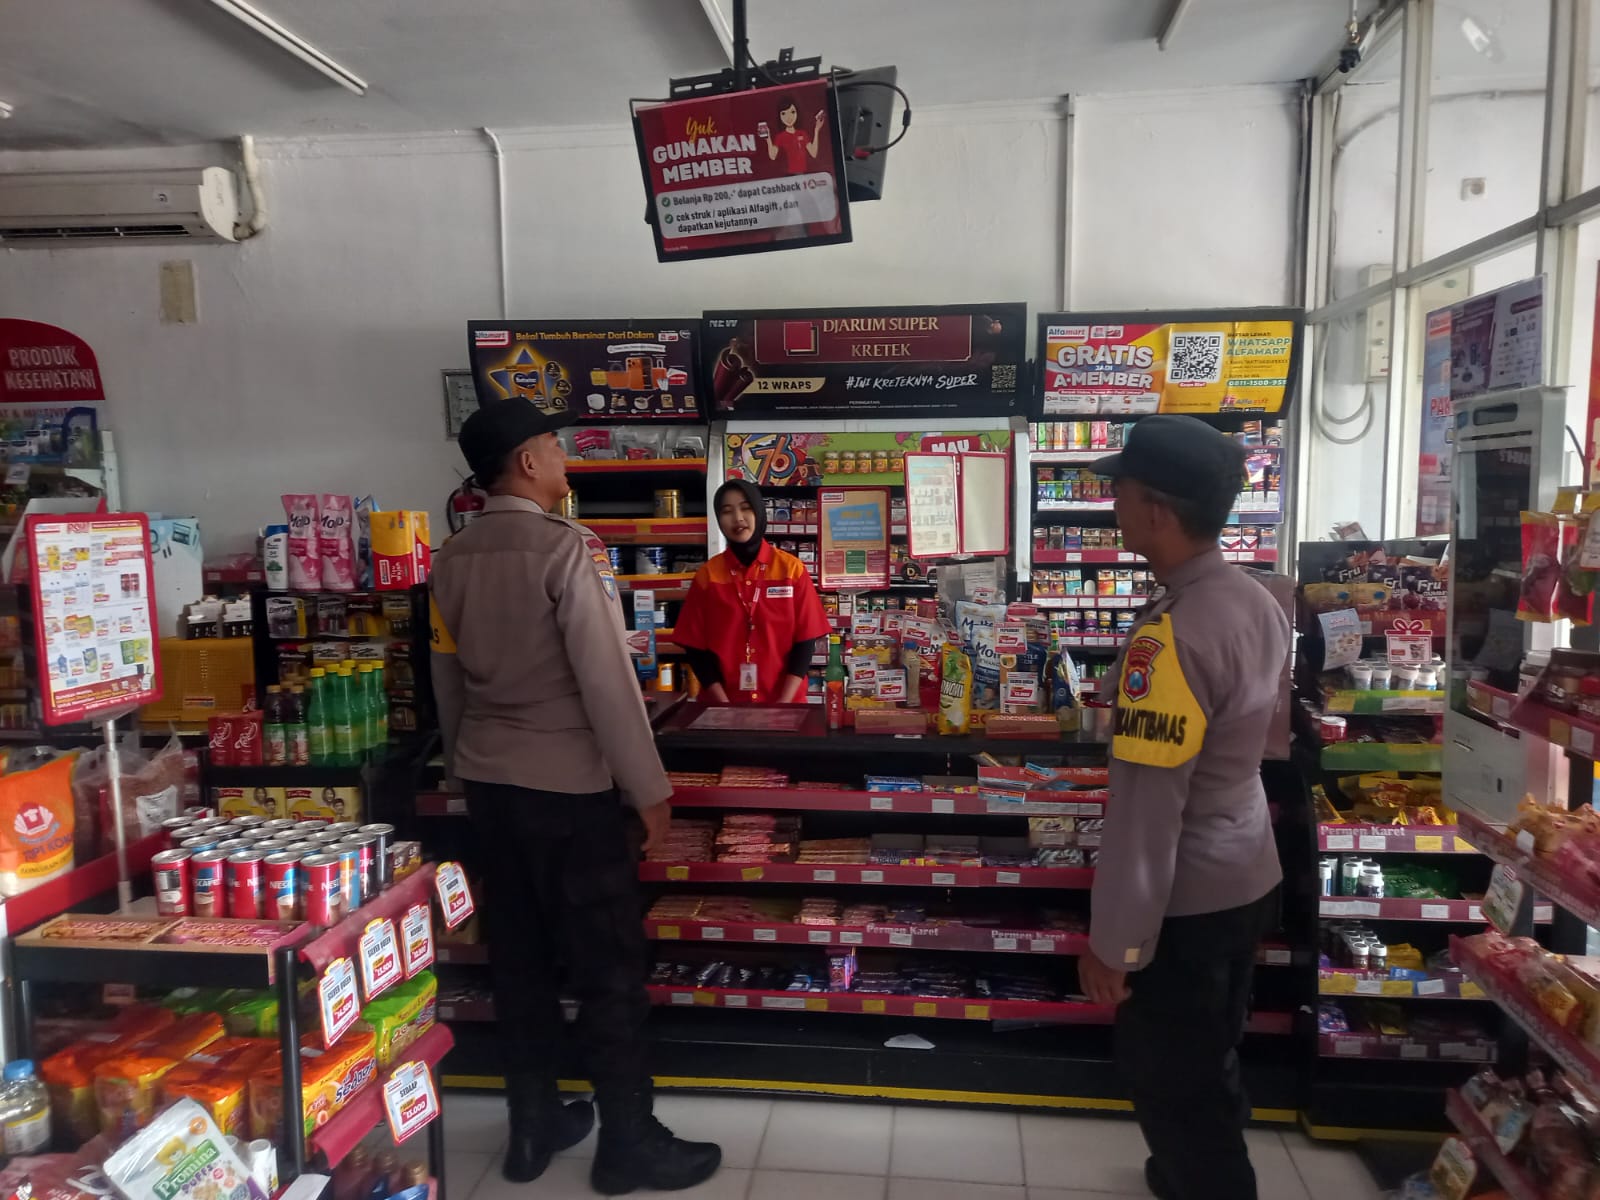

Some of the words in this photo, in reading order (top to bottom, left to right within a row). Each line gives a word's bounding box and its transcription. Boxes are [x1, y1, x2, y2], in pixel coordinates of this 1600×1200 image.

[652, 134, 756, 164] GUNAKAN
[662, 157, 753, 184] MEMBER
[673, 193, 702, 207] Belanja
[703, 193, 713, 204] Rp
[738, 187, 760, 200] dapat
[761, 181, 801, 195] Cashback
[676, 212, 690, 222] cek
[691, 209, 712, 221] struk
[717, 205, 748, 219] aplikasi
[749, 201, 778, 215] Alfagift
[678, 220, 713, 233] dapatkan
[714, 216, 758, 231] kejutannya
[823, 317, 886, 333] DJARUM
[890, 316, 939, 331] SUPER
[1048, 328, 1086, 336] Alfamart
[608, 331, 625, 340] Dari
[627, 331, 654, 340] Dalam
[1227, 337, 1291, 346] WHATSAPP
[8, 345, 80, 369] PRODUK
[851, 342, 911, 357] KRETEK
[1058, 344, 1154, 369] GRATIS
[1226, 347, 1287, 356] ALFAMART
[3, 368, 96, 390] KESEHATAN
[757, 380, 769, 390] 12
[771, 379, 812, 390] WRAPS
[750, 436, 797, 486] 76
[1339, 565, 1361, 582] Fru
[1417, 579, 1443, 592] Fru
[1320, 825, 1367, 836] Permen
[1371, 826, 1405, 837] Karet
[866, 923, 908, 936] Permen
[910, 925, 939, 937] Karet
[992, 929, 1034, 941] Permen
[1036, 931, 1066, 942] Karet
[157, 1148, 217, 1197] Promina
